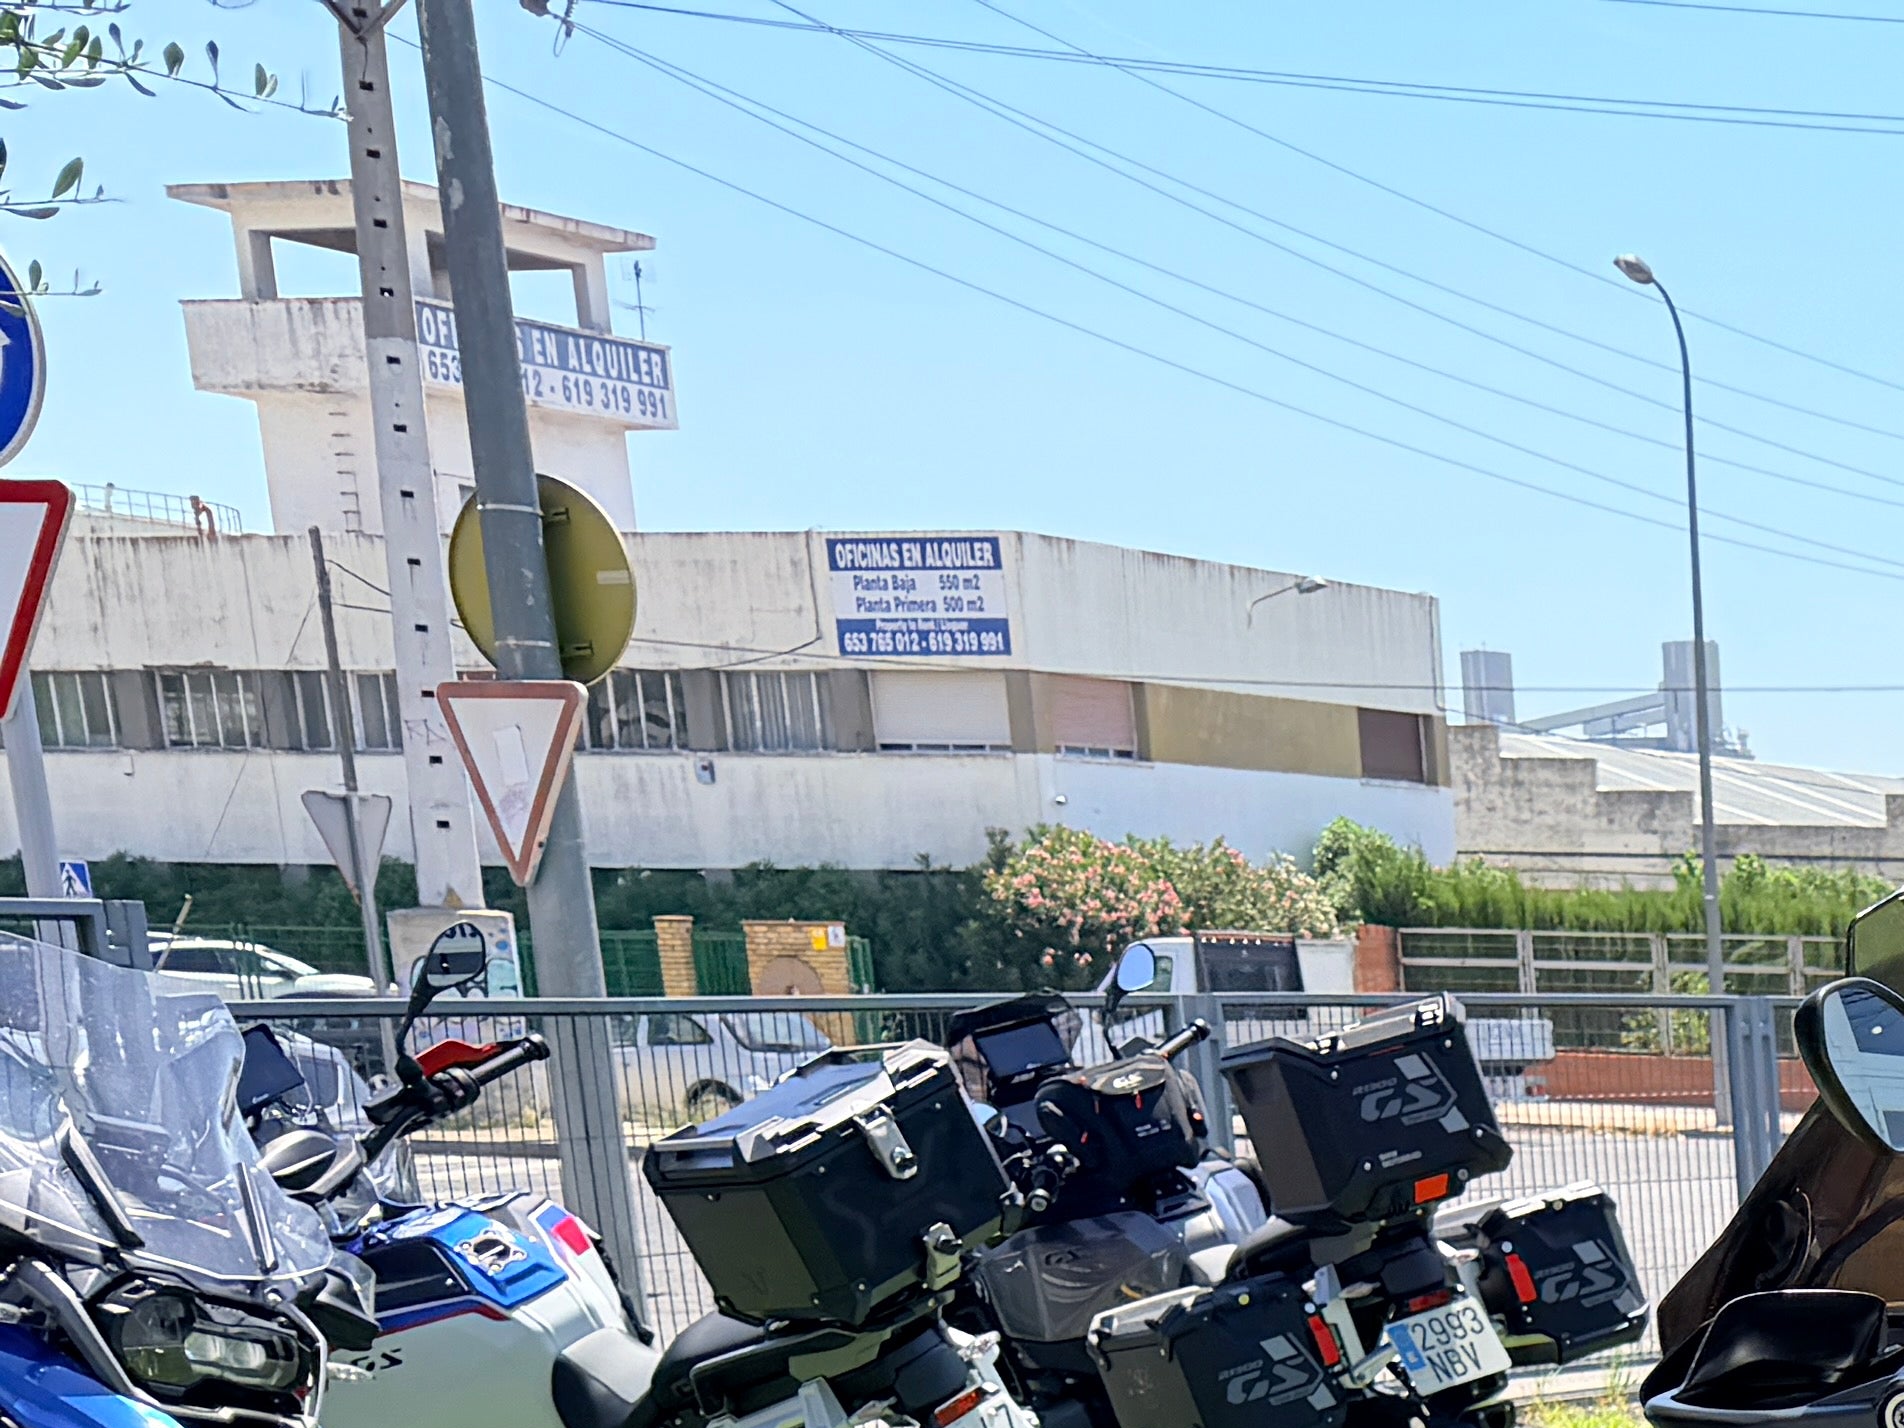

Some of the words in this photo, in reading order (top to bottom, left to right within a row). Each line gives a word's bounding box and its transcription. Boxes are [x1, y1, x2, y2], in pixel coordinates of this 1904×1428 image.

[532, 329, 559, 367] EN
[568, 338, 664, 386] ALQUILER
[562, 375, 593, 406] 619
[601, 382, 631, 414] 319
[638, 390, 667, 419] 991
[835, 542, 900, 568] OFICINAS
[902, 543, 923, 567] EN
[925, 541, 994, 567] ALQUILER
[853, 575, 888, 591] Planta
[892, 574, 916, 593] Baja
[856, 596, 892, 612] Planta
[895, 595, 937, 612] Primera
[844, 631, 867, 652] 653
[869, 631, 893, 652] 765
[895, 631, 920, 652] 012
[928, 631, 952, 652] 619
[954, 631, 978, 652] 319
[980, 631, 1004, 652] 991
[1360, 1076, 1443, 1123] GS
[1411, 1306, 1485, 1353] 2993
[1226, 1356, 1311, 1405] GS
[1426, 1341, 1482, 1383] NBV
